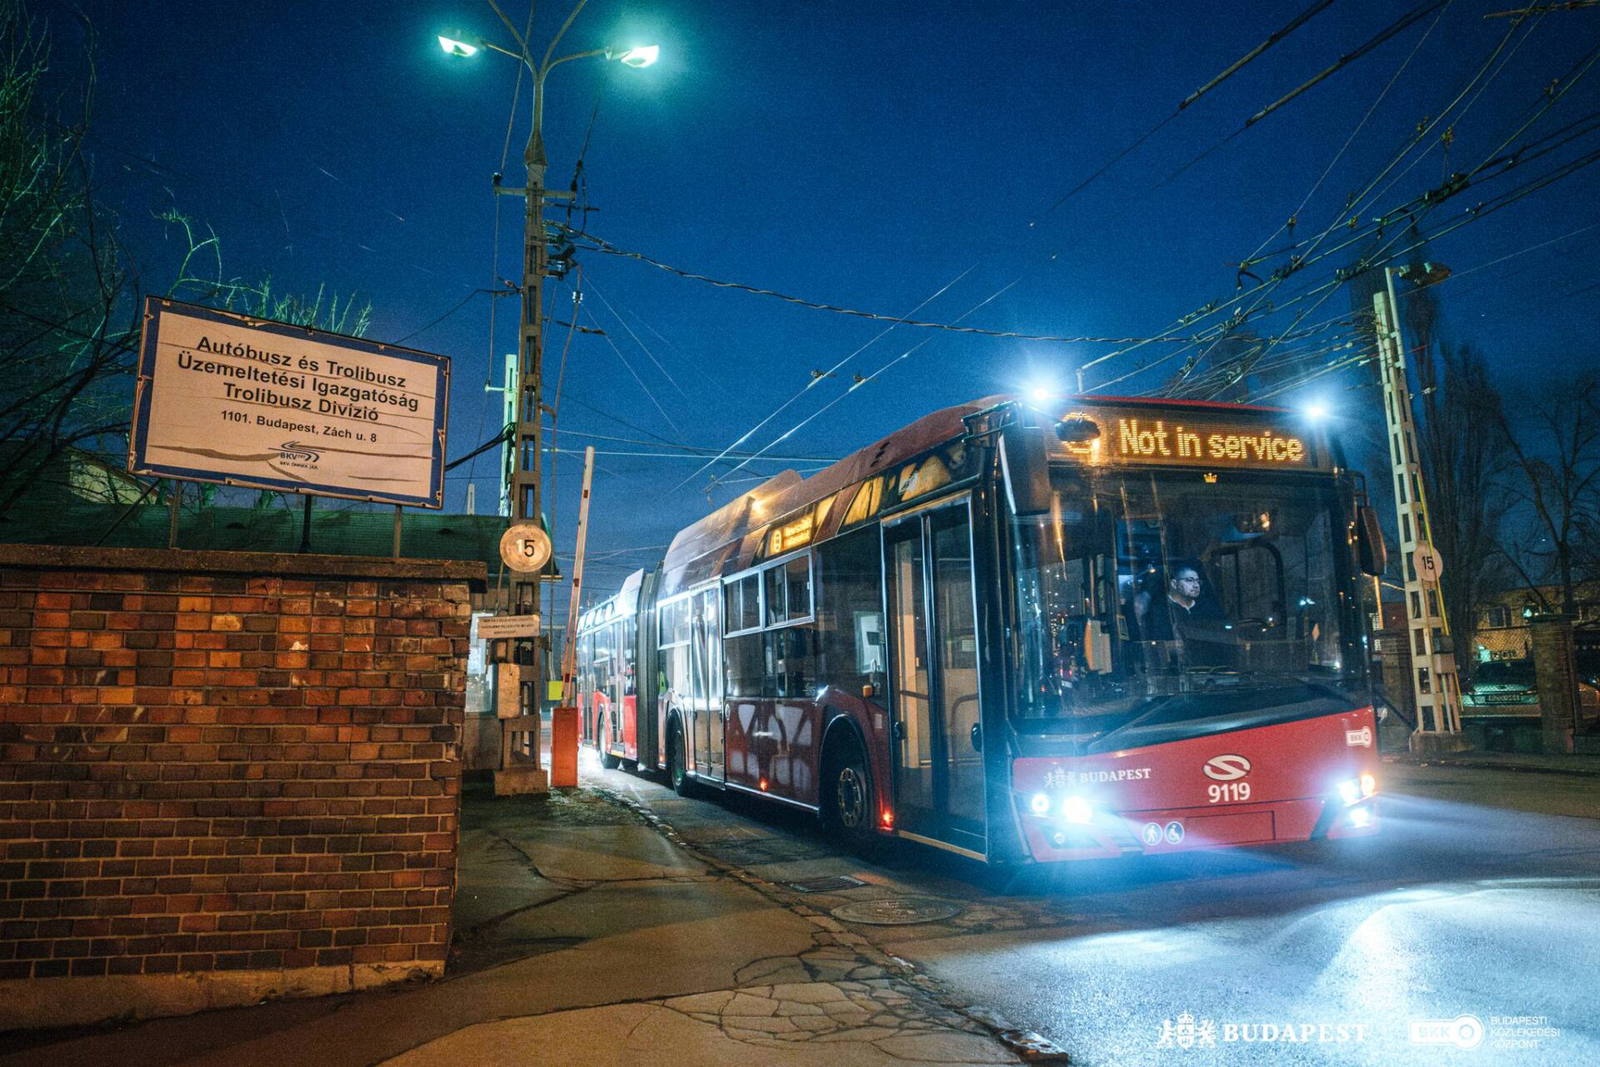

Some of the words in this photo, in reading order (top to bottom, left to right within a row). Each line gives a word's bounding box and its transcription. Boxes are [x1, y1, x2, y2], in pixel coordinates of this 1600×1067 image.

[197, 336, 292, 367] Autóbusz
[298, 354, 320, 371] és
[327, 360, 406, 388] Trolibusz
[177, 350, 305, 389] Üzemeltetési
[312, 377, 419, 412] Igazgatóság
[223, 382, 311, 410] Trolibusz
[318, 399, 379, 421] Divízió
[221, 410, 252, 424] 1101.
[256, 415, 319, 436] Budapest,
[323, 425, 352, 440] Zách
[355, 433, 367, 442] u.
[370, 432, 377, 443] 8
[1119, 419, 1171, 456] Not
[1176, 426, 1202, 457] in
[1208, 431, 1307, 461] service
[1421, 555, 1435, 570] 15
[1080, 768, 1151, 784] BUDAPEST
[1208, 783, 1251, 803] 9119
